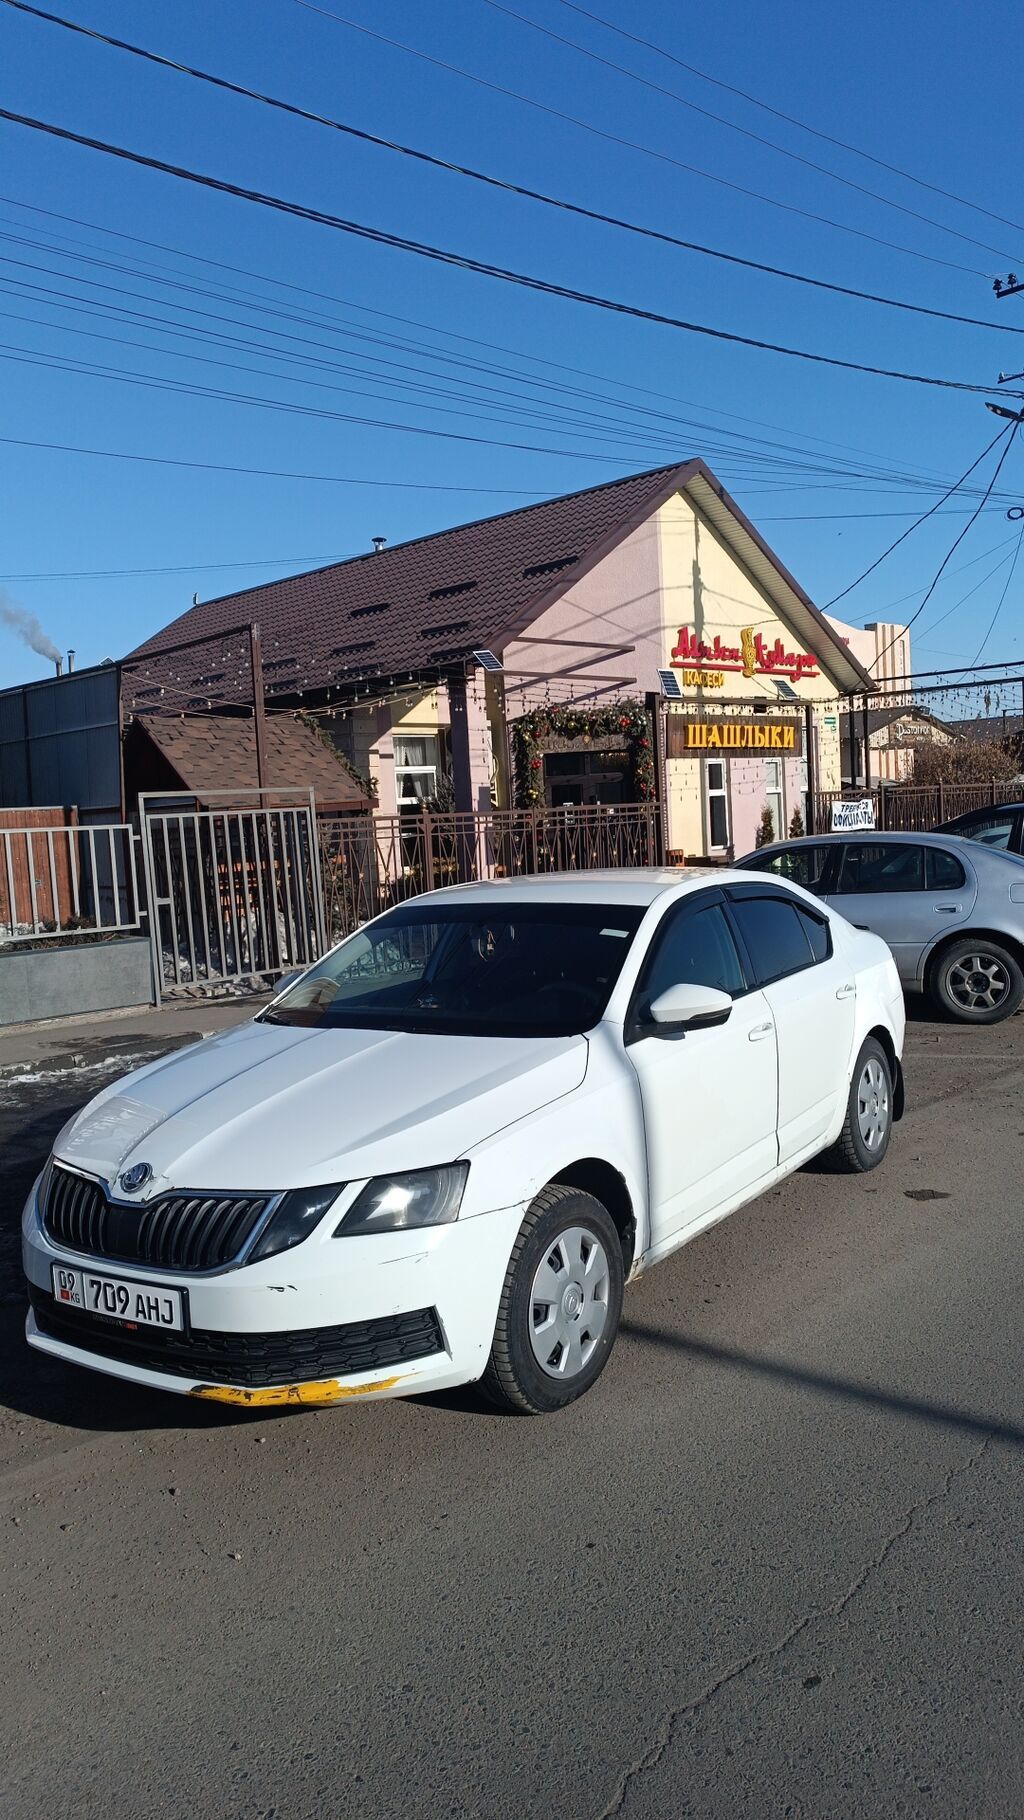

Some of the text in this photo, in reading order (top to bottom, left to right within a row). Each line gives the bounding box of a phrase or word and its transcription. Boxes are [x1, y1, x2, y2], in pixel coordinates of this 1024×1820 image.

[687, 724, 795, 748] ШАШЛЫКИ
[841, 801, 869, 812] ТРЕБУСЯ
[59, 1270, 75, 1291] 09
[70, 1292, 81, 1303] KG
[89, 1279, 129, 1314] 709
[135, 1294, 174, 1324] AHJ
